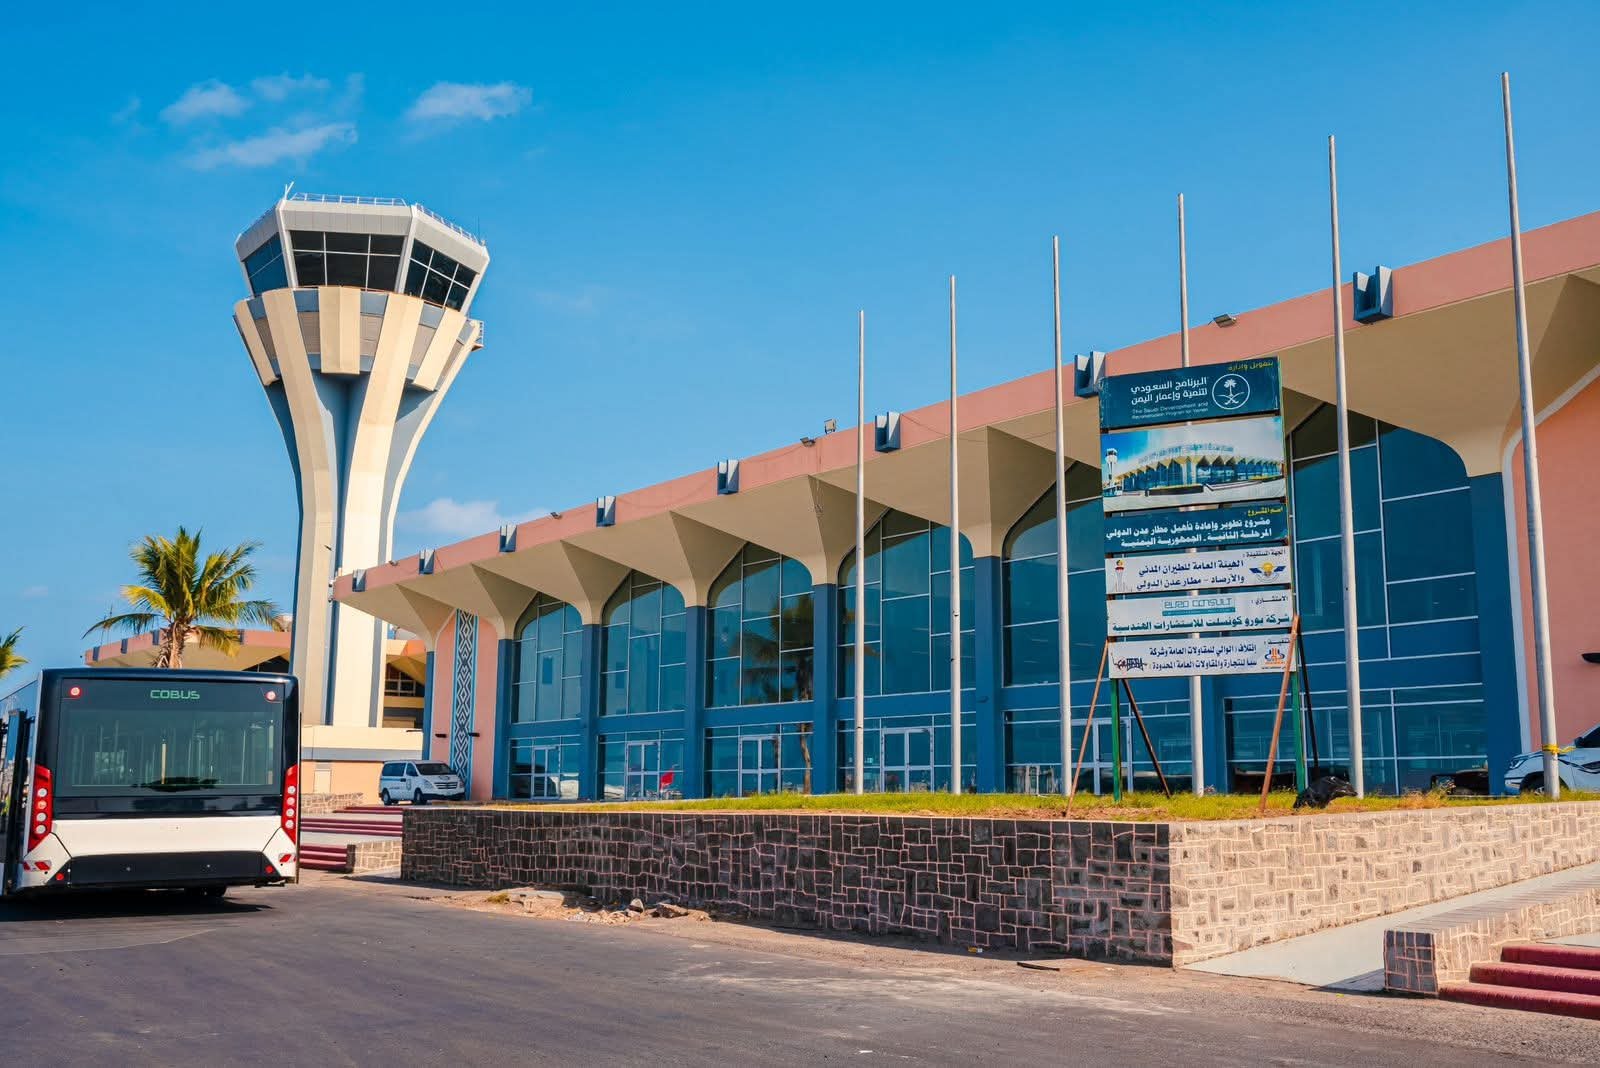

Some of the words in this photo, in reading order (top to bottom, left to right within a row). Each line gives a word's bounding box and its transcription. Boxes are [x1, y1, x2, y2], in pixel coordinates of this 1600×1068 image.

[1130, 380, 1173, 395] السعودي
[1175, 376, 1207, 391] البرنامج
[1131, 394, 1153, 406] اليمن
[1154, 391, 1180, 403] وإعمار
[1244, 517, 1271, 528] مشروع
[1105, 527, 1132, 540] الدولي
[1133, 527, 1149, 537] عدن
[1150, 525, 1168, 536] مطار
[1240, 528, 1272, 539] المرحلة
[1121, 537, 1156, 548] اليمنية
[1156, 533, 1202, 546] الجمهورية
[1138, 565, 1161, 577] المدني
[1162, 563, 1191, 574] للطيران
[1193, 561, 1217, 570] العامة
[1136, 579, 1163, 591] الدولي
[1164, 579, 1181, 588] عدن
[1183, 577, 1202, 587] مطار
[1153, 619, 1204, 631] للاستشارات
[1265, 614, 1290, 625] شركة
[1112, 621, 1152, 631] الهندسية
[150, 690, 200, 700] COBUS
